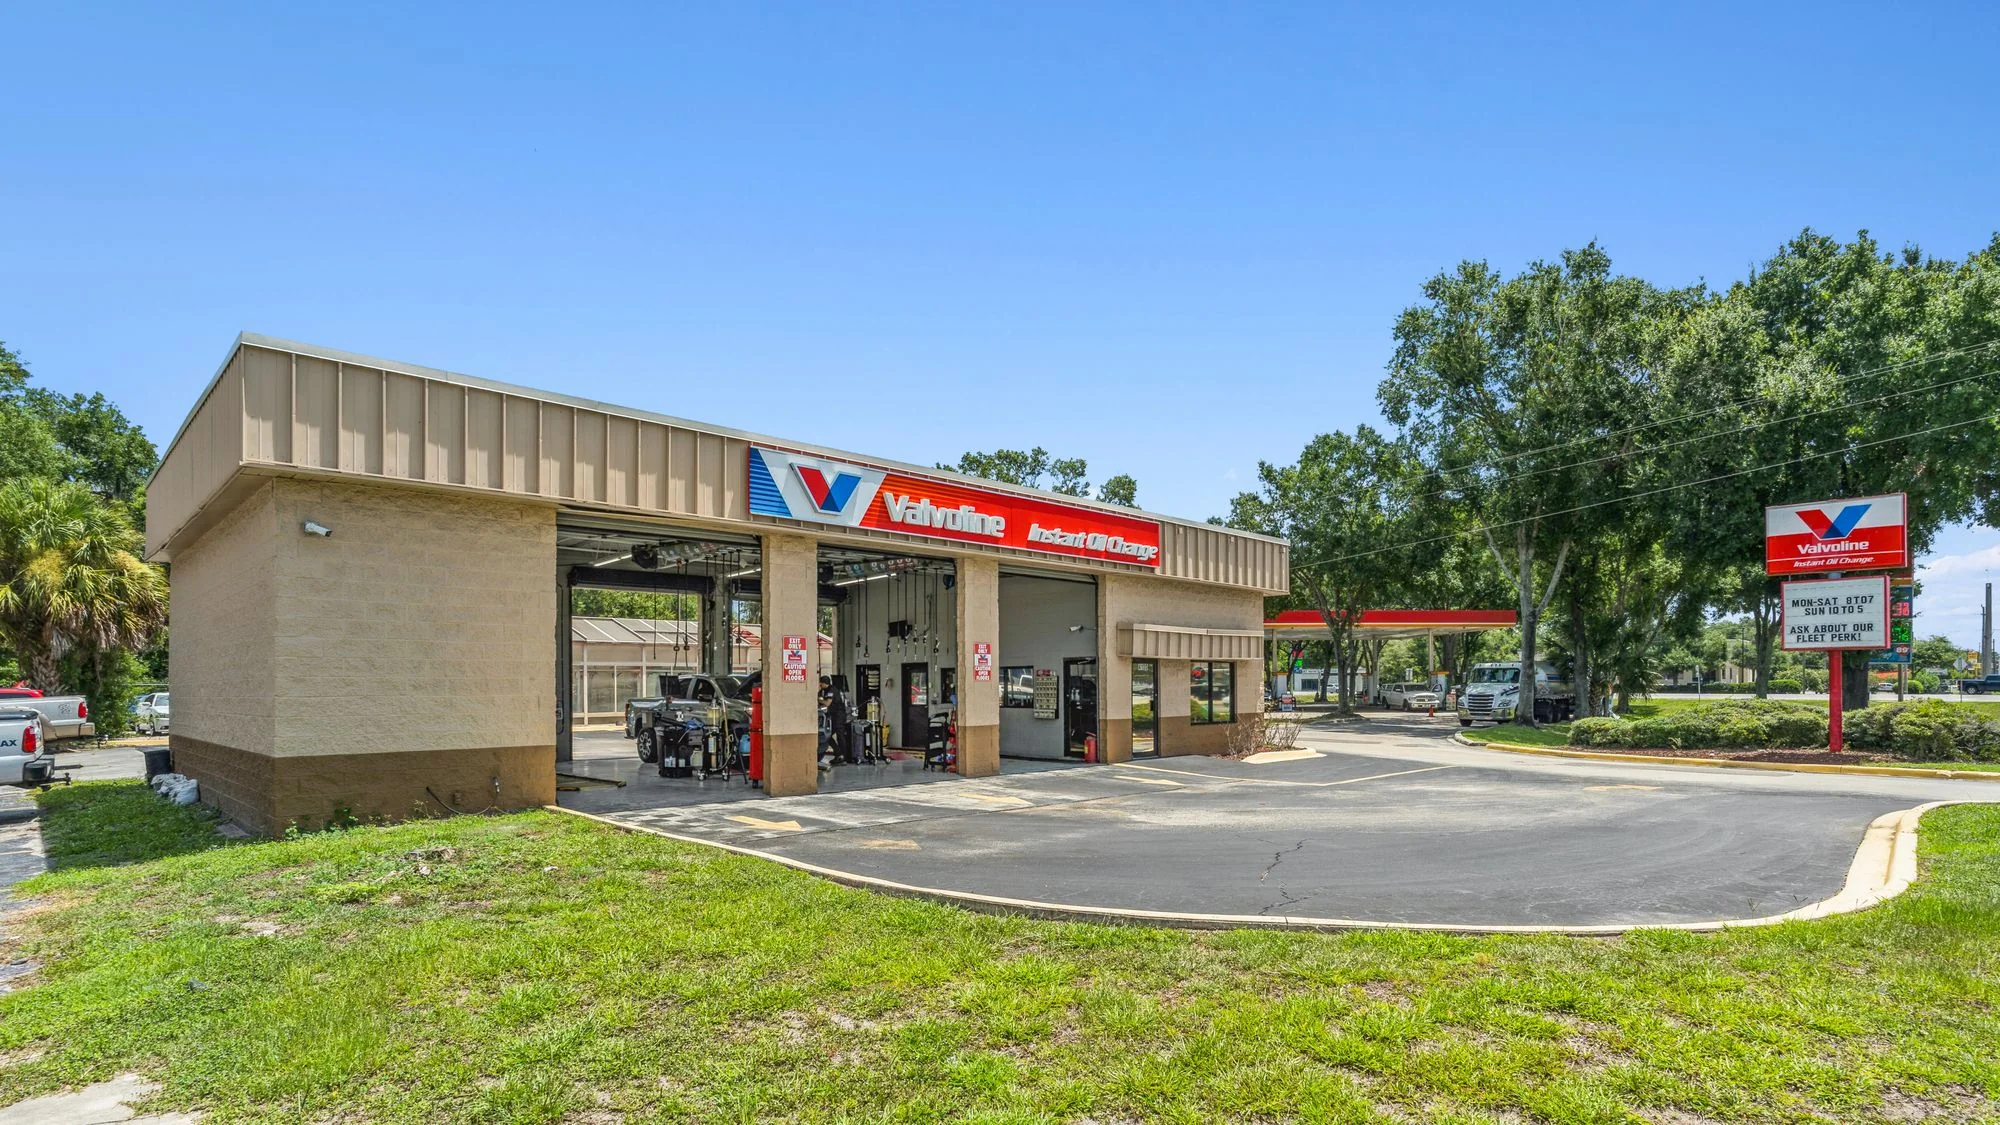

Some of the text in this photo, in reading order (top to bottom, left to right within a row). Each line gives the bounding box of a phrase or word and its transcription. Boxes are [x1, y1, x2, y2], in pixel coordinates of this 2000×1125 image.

[882, 491, 1006, 538] Valvoline
[1027, 523, 1159, 561] Instant Oil Change
[1797, 540, 1870, 555] Valvoline
[1793, 560, 1826, 568] Instant
[1825, 557, 1839, 566] Oil
[1791, 597, 1838, 608] MON-SAT
[1805, 605, 1864, 616] SUN 10 TO 5
[1790, 623, 1874, 634] ASK ABOUT OUR
[1796, 632, 1861, 643] FLEET PERK!
